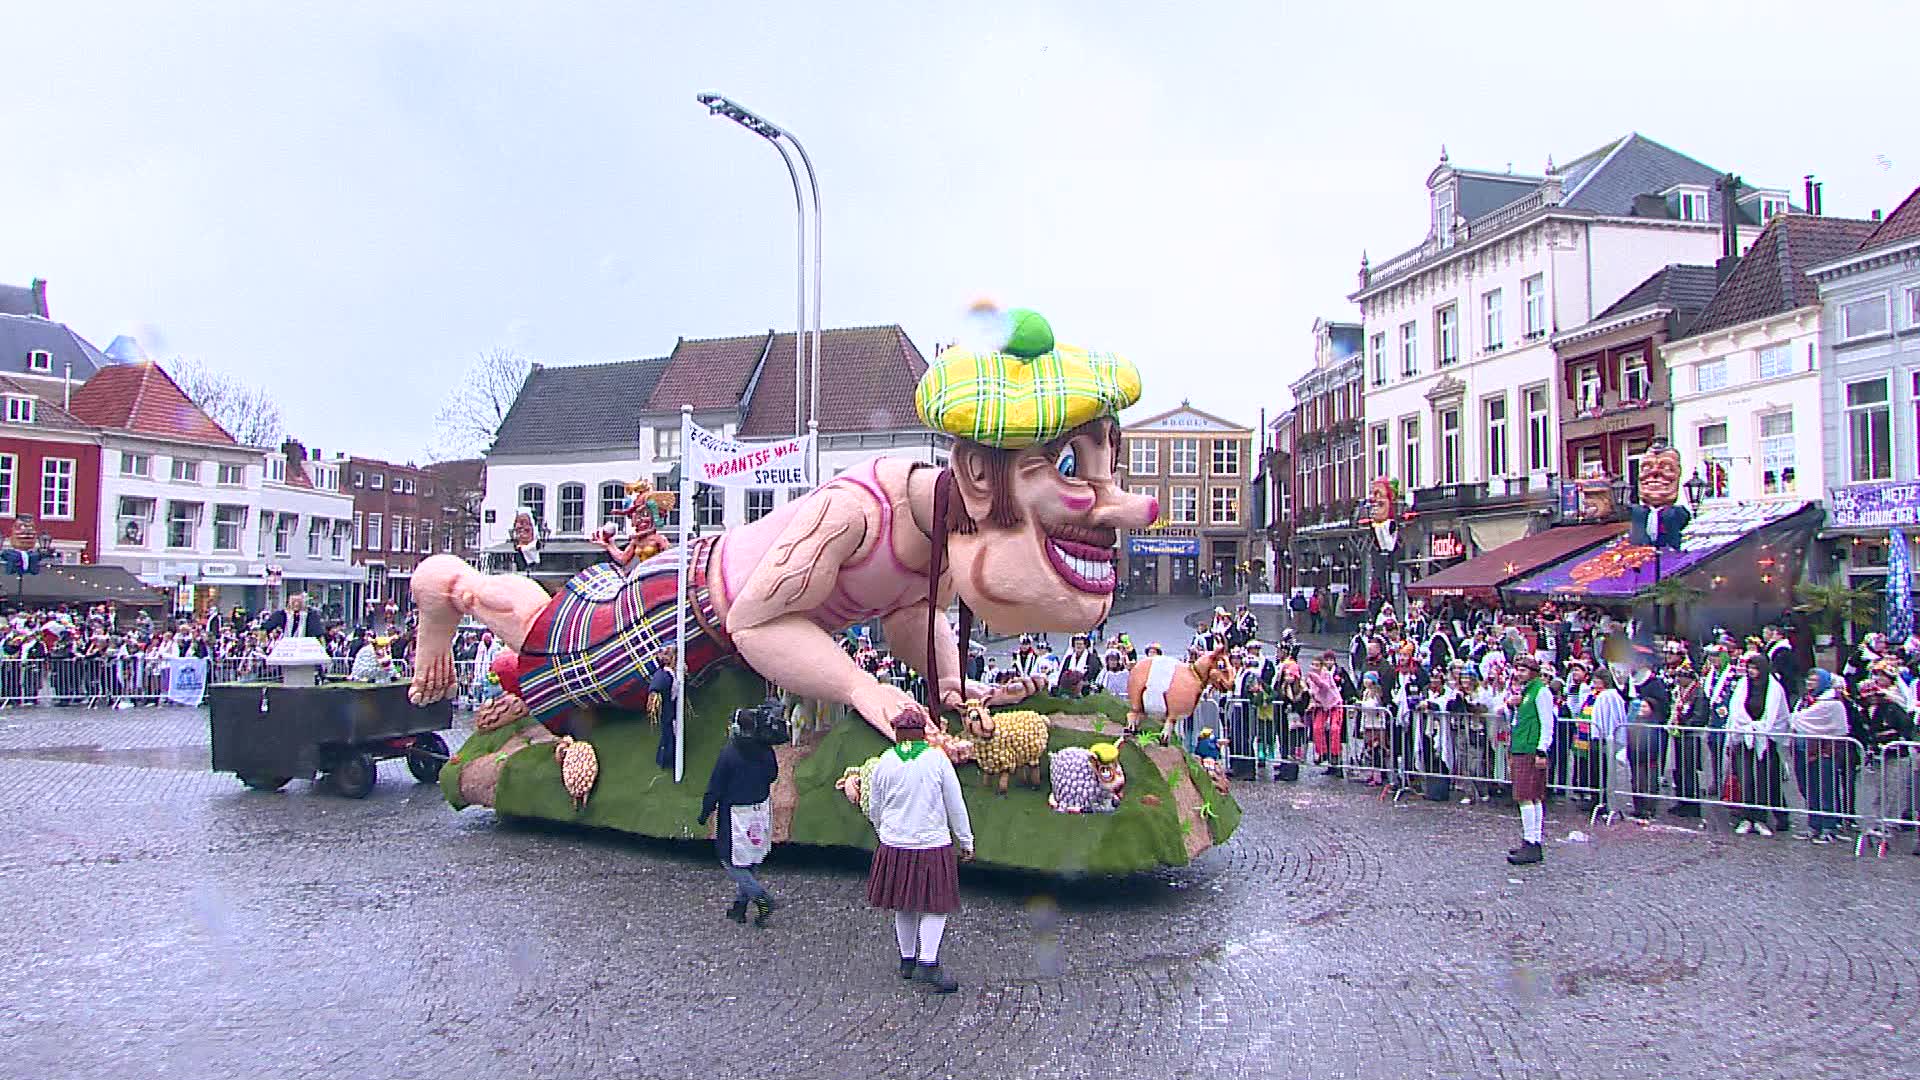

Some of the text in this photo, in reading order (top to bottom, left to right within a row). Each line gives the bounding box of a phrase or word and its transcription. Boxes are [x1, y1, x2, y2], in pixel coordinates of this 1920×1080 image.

[754, 468, 801, 484] SPEULE
[1129, 528, 1197, 536] DEN ENGHEL
